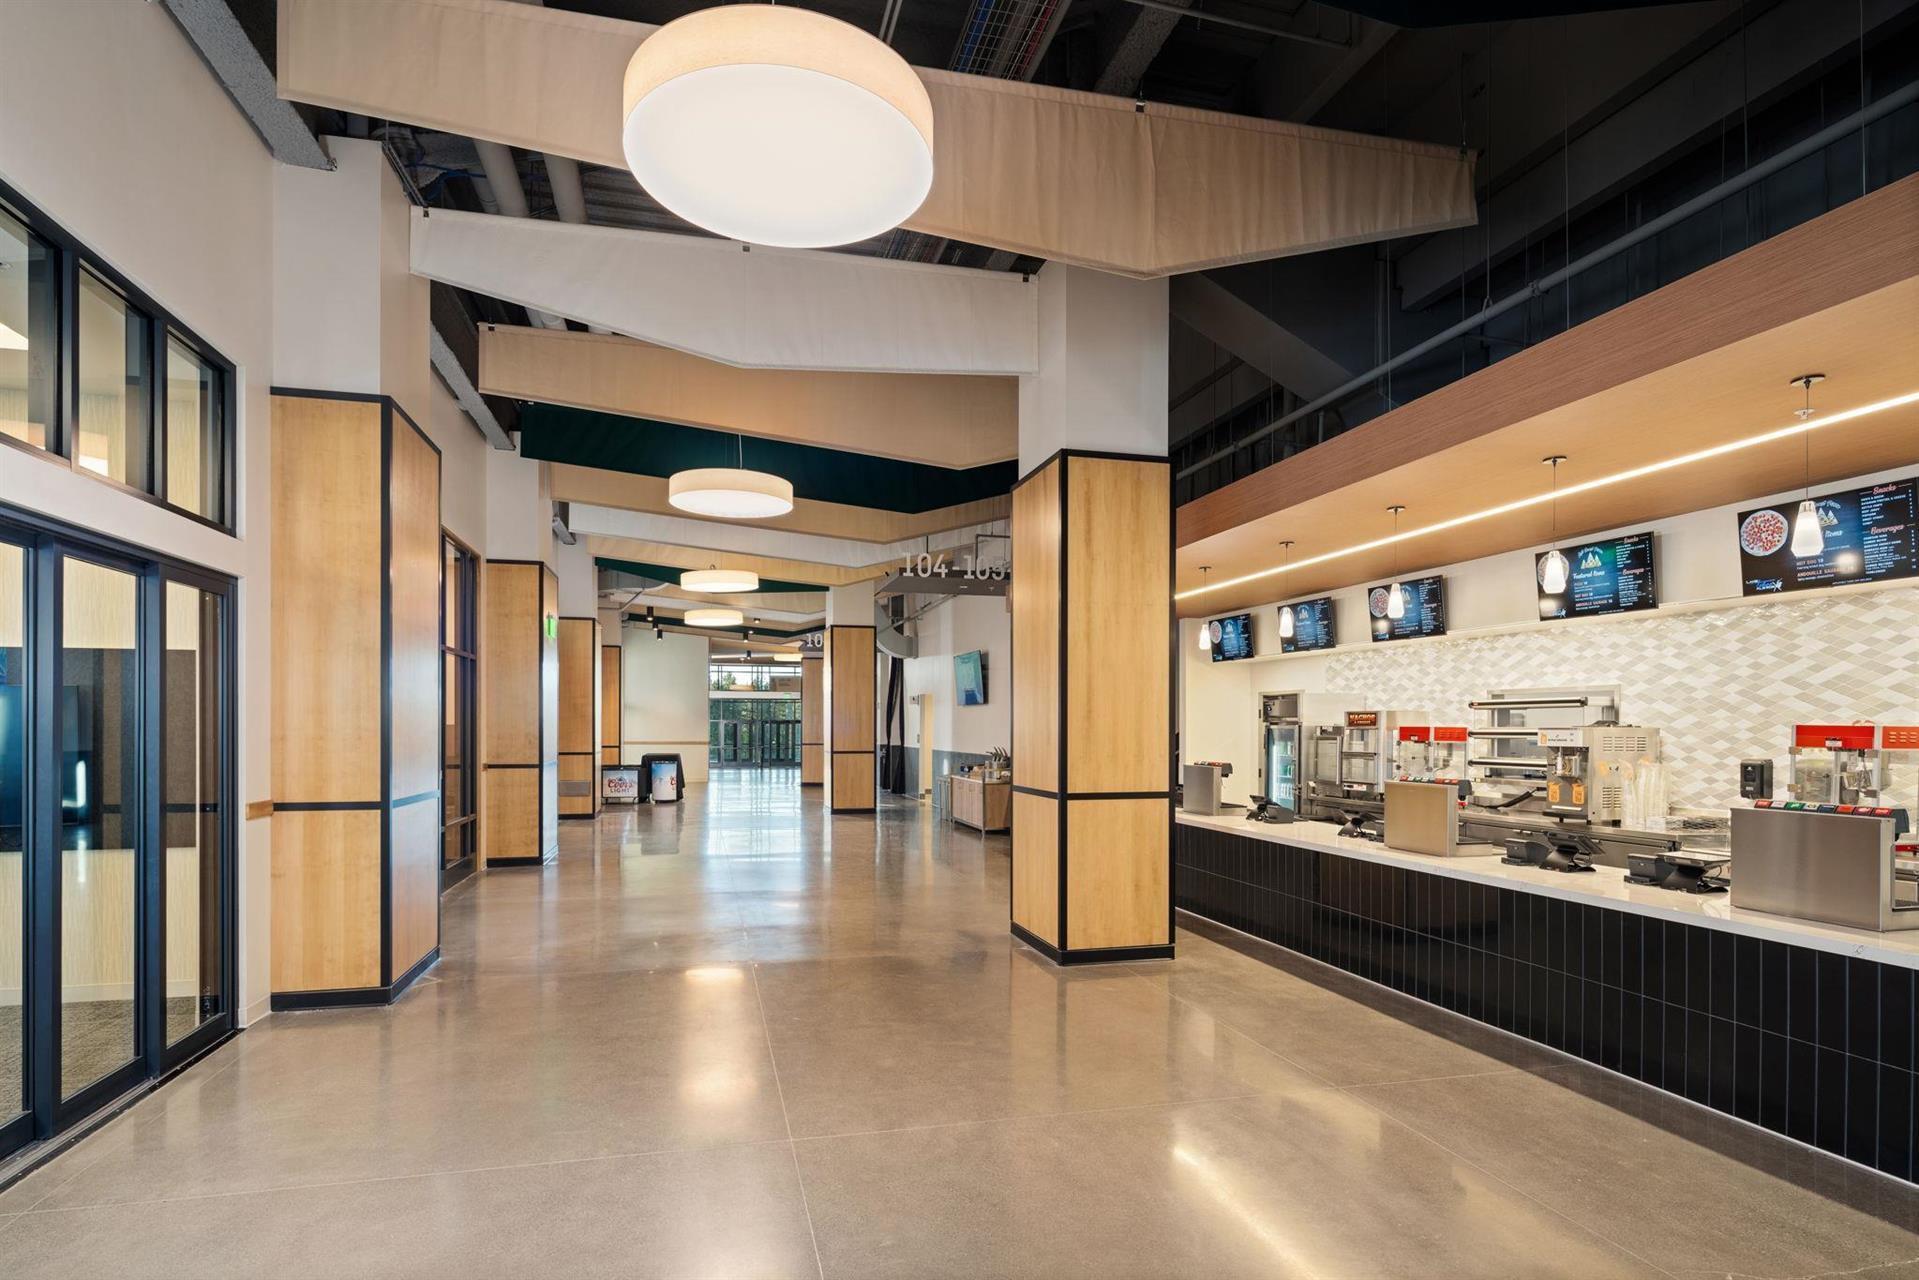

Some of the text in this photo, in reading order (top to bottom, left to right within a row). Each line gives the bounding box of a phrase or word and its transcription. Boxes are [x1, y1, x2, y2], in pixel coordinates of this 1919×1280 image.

[1873, 484, 1897, 494] Snacks
[1871, 525, 1904, 534] Beverages
[608, 778, 632, 788] Coors
